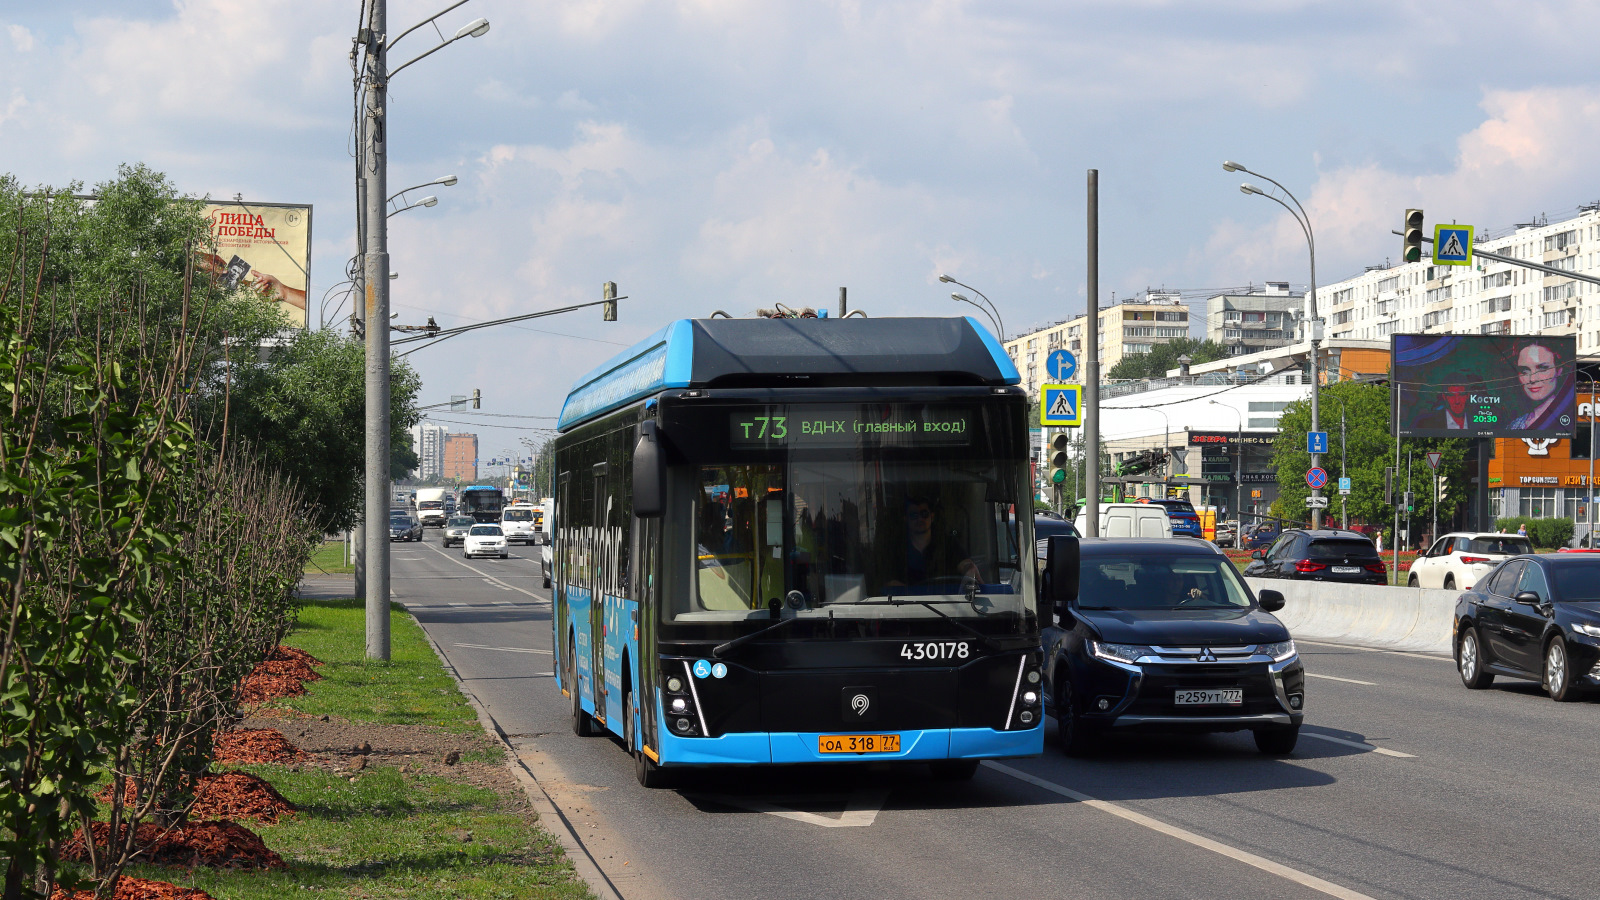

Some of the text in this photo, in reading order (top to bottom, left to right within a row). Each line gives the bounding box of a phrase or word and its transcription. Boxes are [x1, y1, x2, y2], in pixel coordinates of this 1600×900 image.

[219, 213, 265, 230] ЛИЦА
[219, 226, 276, 239] ПОБЕДЫ
[1470, 394, 1501, 404] Кости
[1473, 415, 1498, 423] 20:30
[802, 420, 846, 435] ВДНХ
[853, 419, 917, 434] (главный
[923, 418, 966, 434] вход)
[1192, 435, 1227, 443] ЗЕБРА
[1519, 476, 1530, 484] TOP
[1532, 476, 1544, 484] GUN
[1564, 475, 1581, 485] ИЗИ
[900, 641, 970, 660] 430178
[1178, 690, 1240, 703] Р259УТ 777
[825, 736, 896, 751] ОА 318 77
